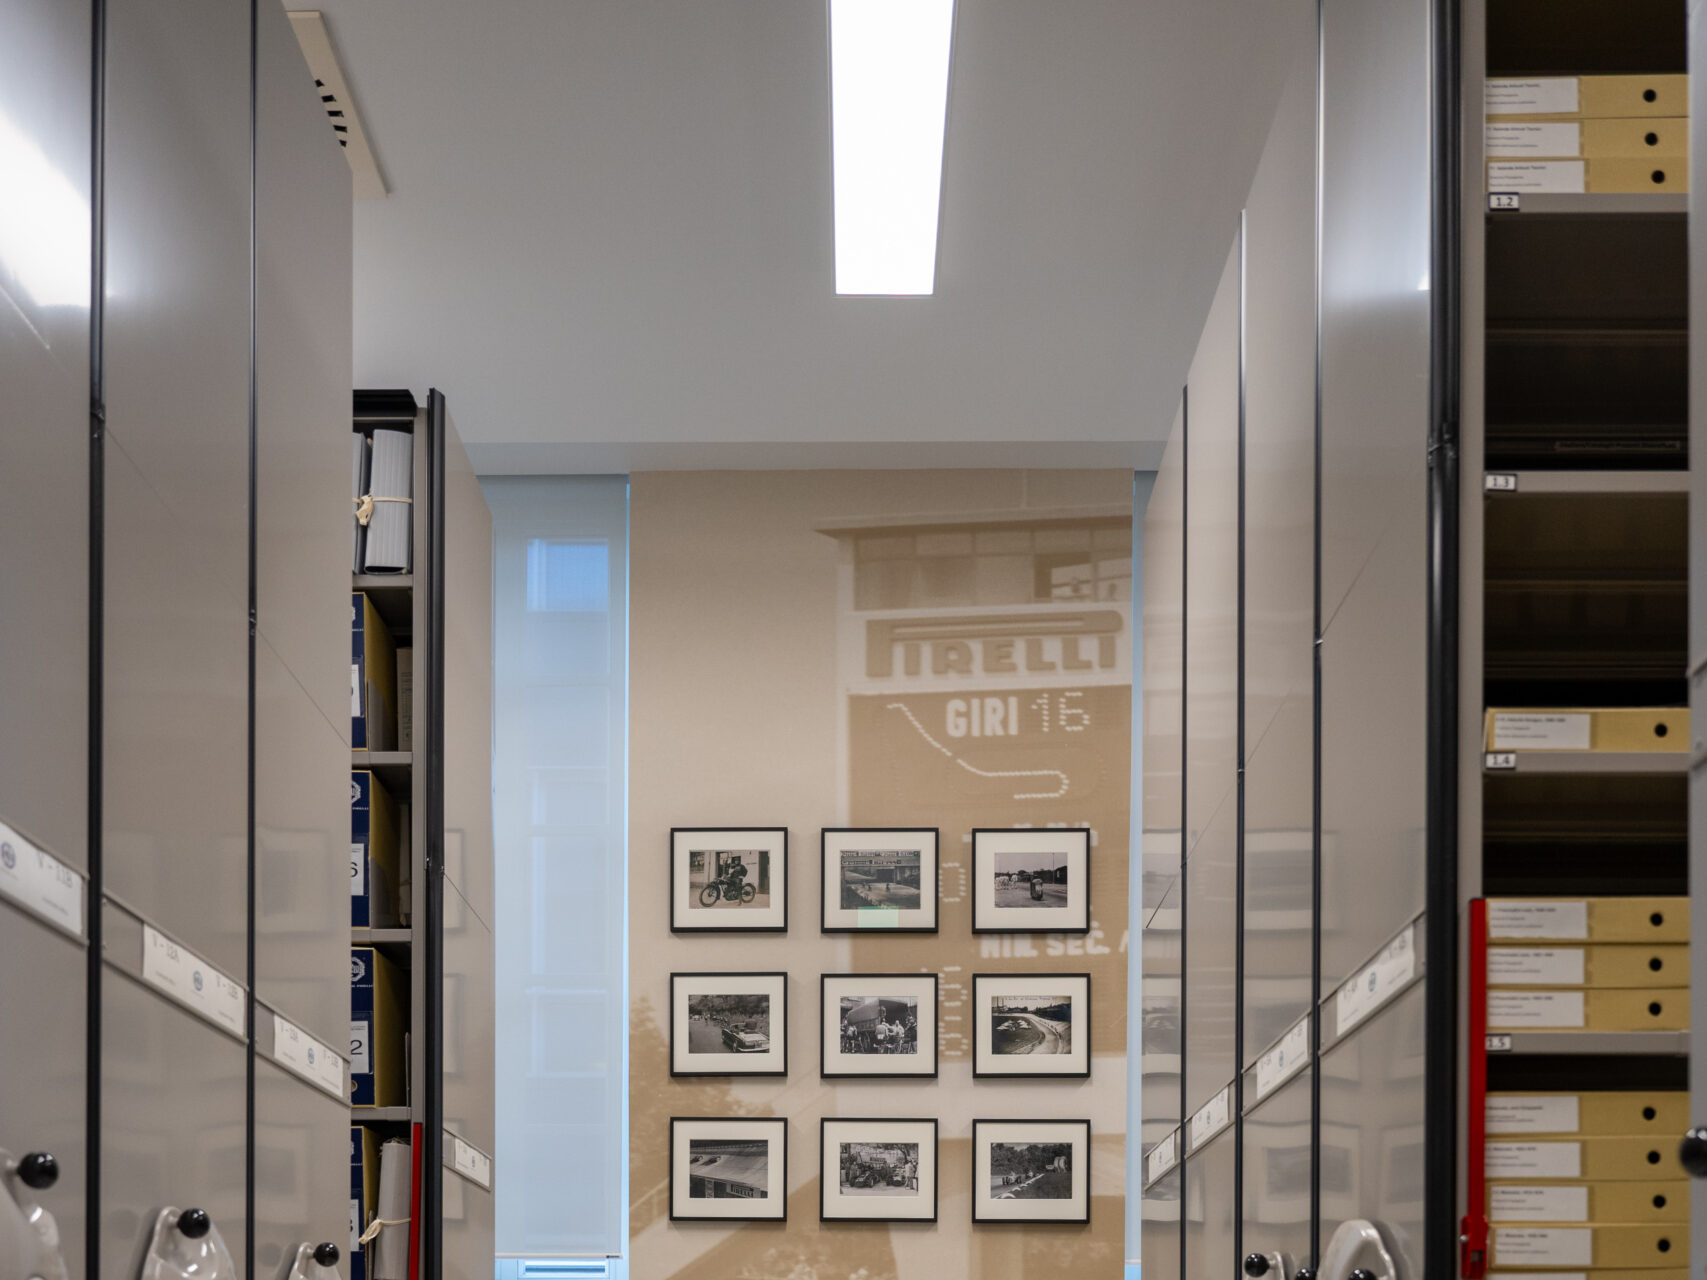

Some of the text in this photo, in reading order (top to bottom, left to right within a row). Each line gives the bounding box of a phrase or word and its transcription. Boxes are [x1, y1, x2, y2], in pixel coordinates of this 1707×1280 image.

[1495, 195, 1514, 207] 1.2
[865, 609, 1124, 679] PIRELLI
[945, 696, 1019, 738] GIRI
